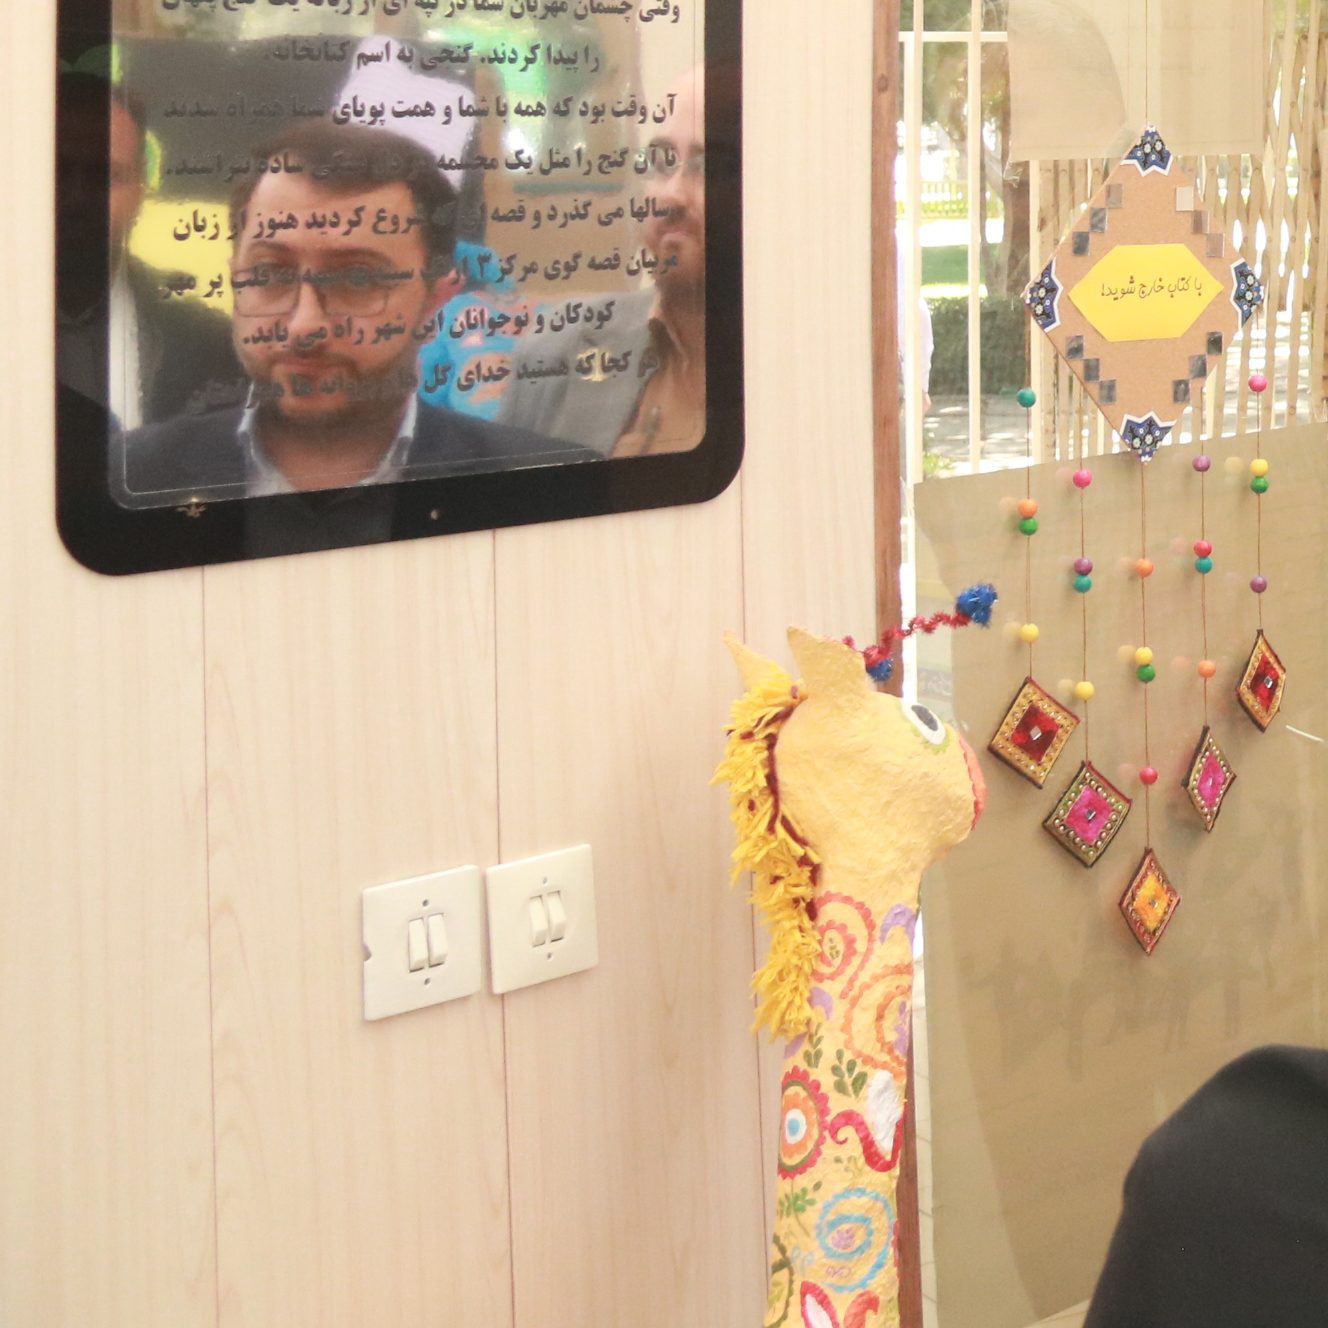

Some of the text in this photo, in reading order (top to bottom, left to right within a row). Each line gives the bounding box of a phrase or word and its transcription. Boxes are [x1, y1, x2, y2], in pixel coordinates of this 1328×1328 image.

[356, 40, 391, 70] اسم
[397, 46, 415, 69] به
[420, 42, 474, 71] گنجی
[546, 43, 578, 73] پیدا
[584, 44, 599, 72] را
[332, 93, 678, 126] آن وقت بود که همه با شما همت پویای
[505, 149, 533, 174] یک
[539, 148, 571, 176] مثل
[577, 148, 592, 176] را
[598, 147, 630, 175] گنج
[634, 144, 657, 174] آن
[173, 208, 220, 241] زبان
[253, 210, 298, 239] هنوز
[305, 205, 366, 236] کردید
[491, 199, 526, 223] قصه
[547, 199, 592, 228] گذرد
[597, 209, 624, 227] می
[496, 254, 539, 283] مرکز
[543, 250, 583, 280] گوی
[587, 247, 621, 271] قصه
[203, 273, 224, 299] پر
[1139, 277, 1164, 299] خارج
[1167, 276, 1192, 298] کتاب
[1194, 276, 1202, 297] با
[371, 314, 406, 345] شهر
[450, 305, 529, 338] نوجوانان
[550, 300, 615, 332] کودکان
[333, 317, 364, 345] راه
[457, 359, 511, 392] خدای
[517, 361, 568, 384] هستید
[575, 352, 595, 375] که
[600, 350, 632, 379] کجا
[424, 364, 453, 393] گل
